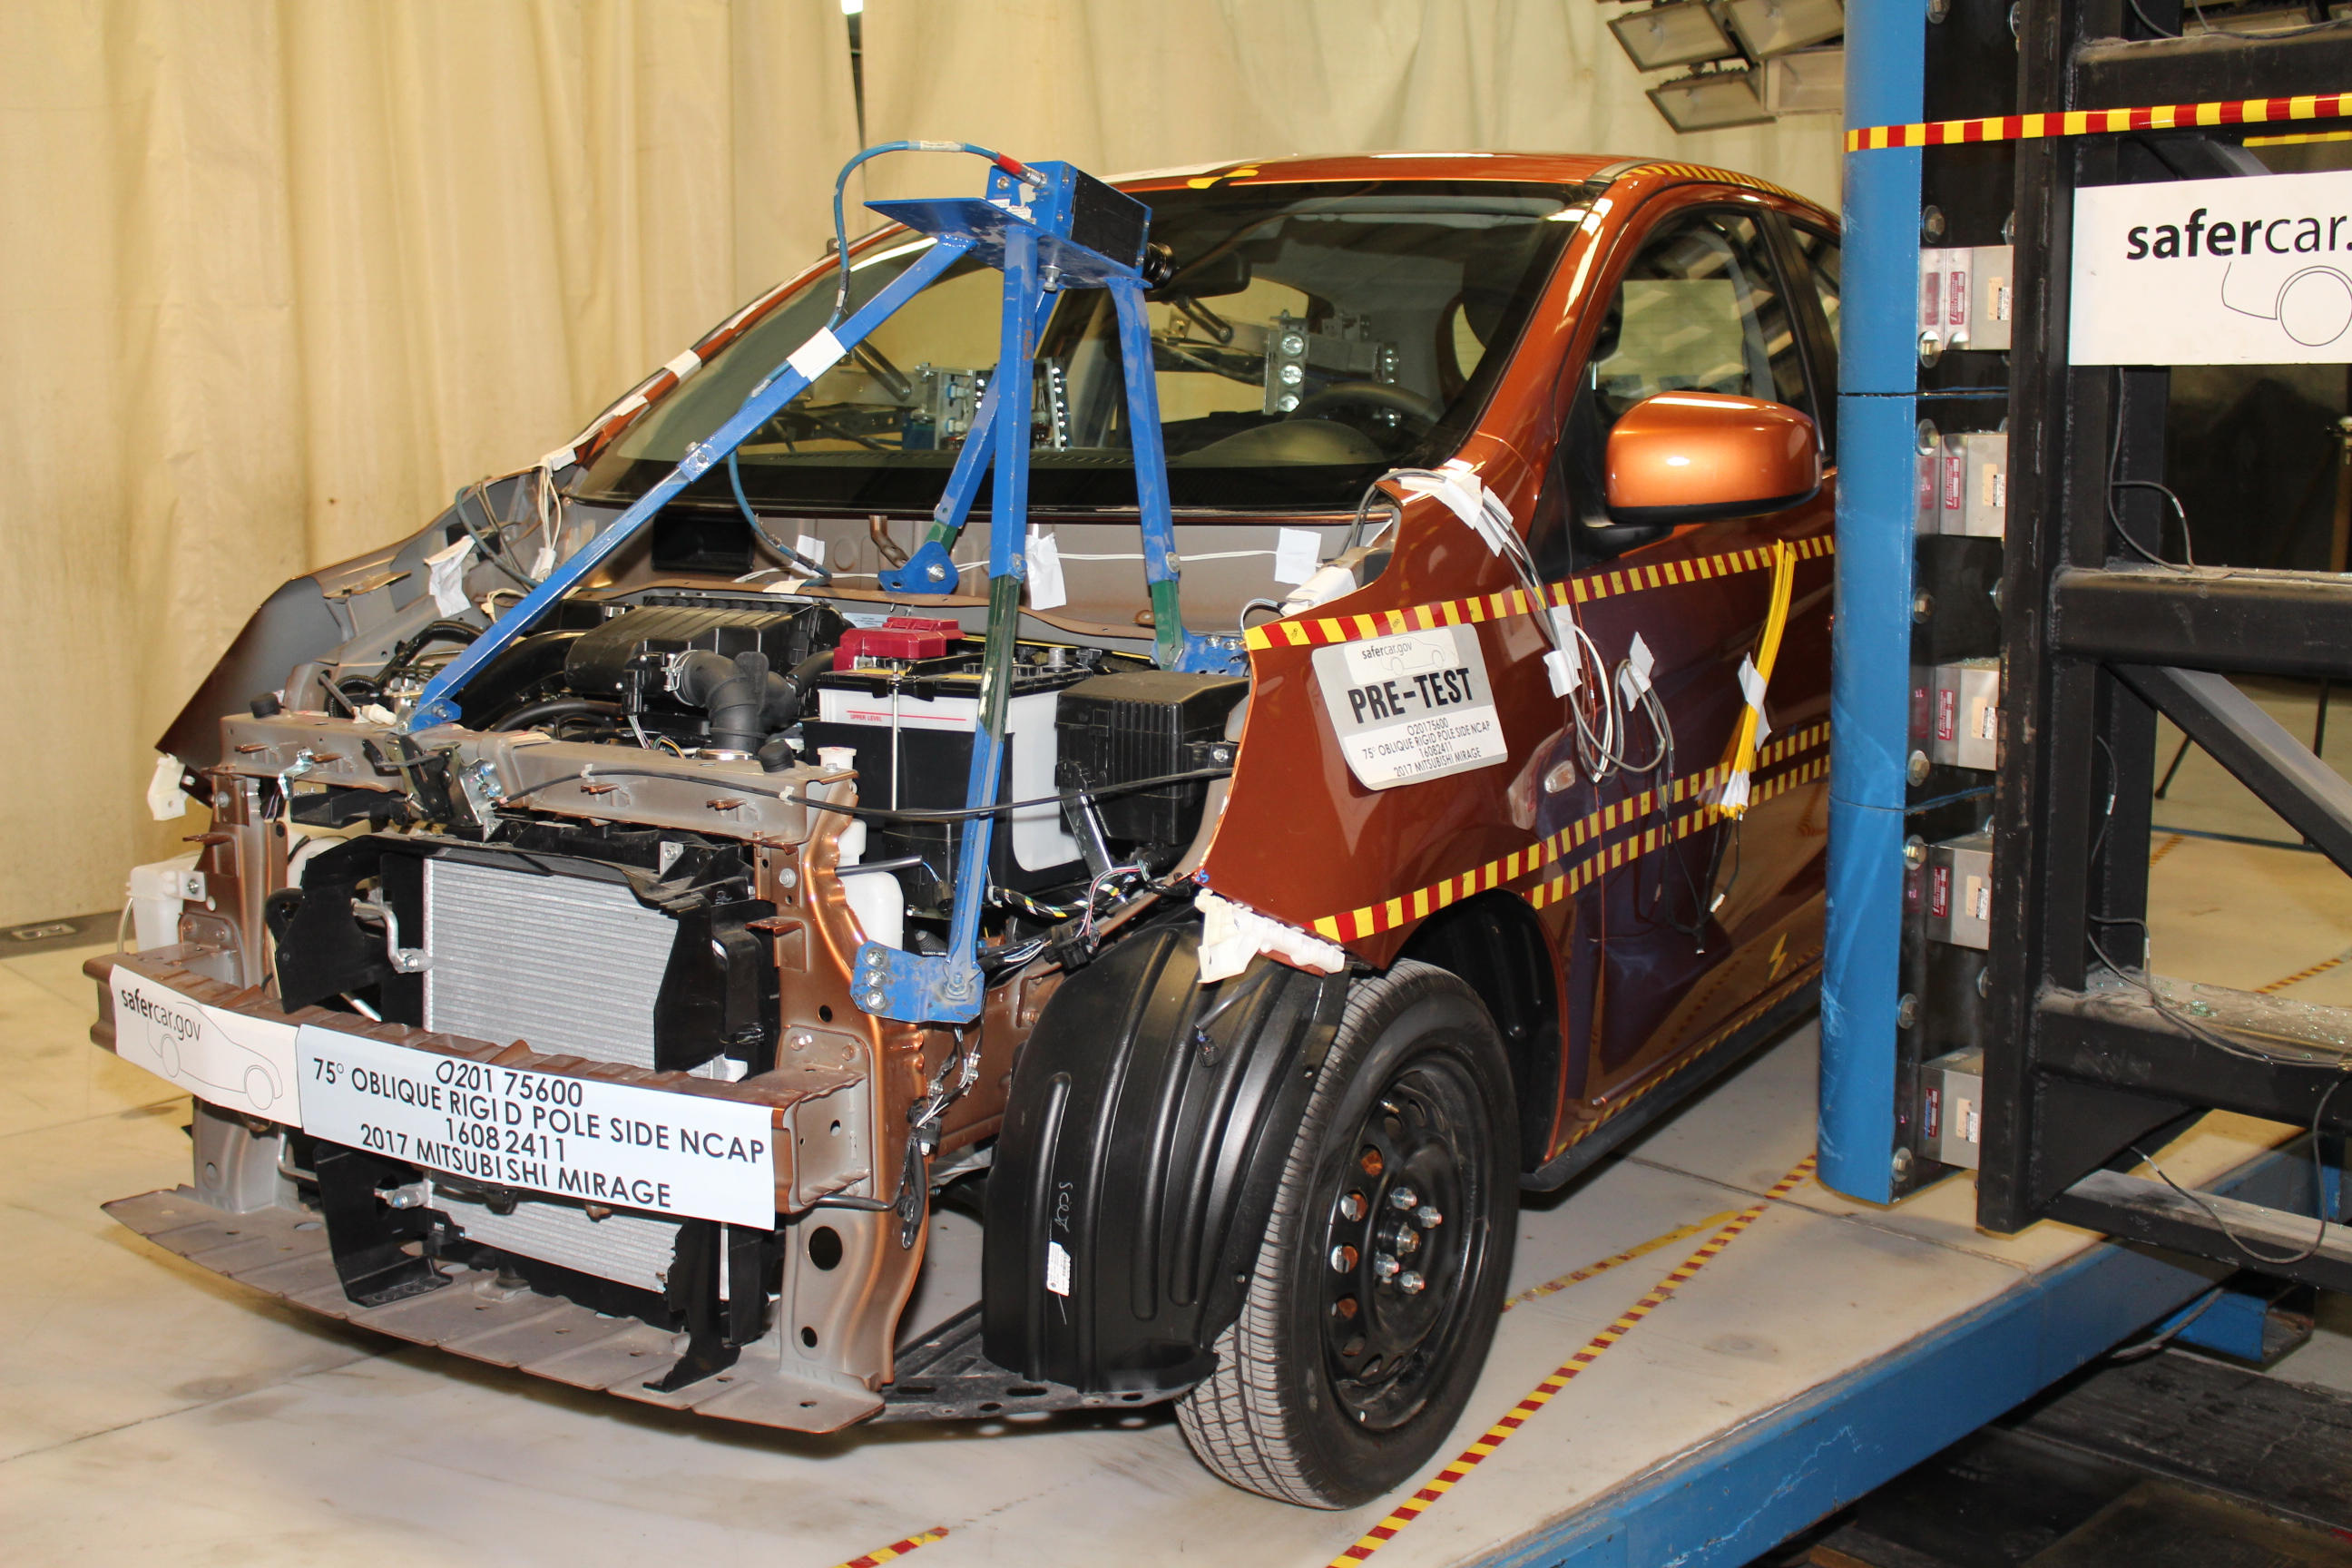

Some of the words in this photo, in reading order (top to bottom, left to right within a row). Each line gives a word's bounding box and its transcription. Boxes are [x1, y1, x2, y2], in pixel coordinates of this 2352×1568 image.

[1362, 642, 1413, 661] safercar.gov
[1348, 667, 1473, 724] PRE-TEST
[1378, 738, 1414, 757] OBLIQUE
[1415, 732, 1436, 750] RIGID
[1436, 728, 1455, 745] POLE
[1455, 724, 1470, 740] SIDE
[1471, 720, 1491, 735] NCAP
[1418, 742, 1453, 759] 16082411
[1393, 764, 1414, 778] 2017
[1416, 753, 1454, 773] MITSUBISHI
[1455, 747, 1482, 763] MIRAGE
[121, 988, 201, 1042] safercar.gov
[352, 1067, 441, 1111] OBLIQUE
[450, 1090, 522, 1125] RIGID
[534, 1105, 600, 1139] POLE
[611, 1117, 670, 1151] SIDE
[681, 1128, 765, 1164] NCAP
[362, 1124, 407, 1154] 2017
[417, 1132, 546, 1187] MITSUBISHI
[559, 1167, 671, 1209] MIRAGE
